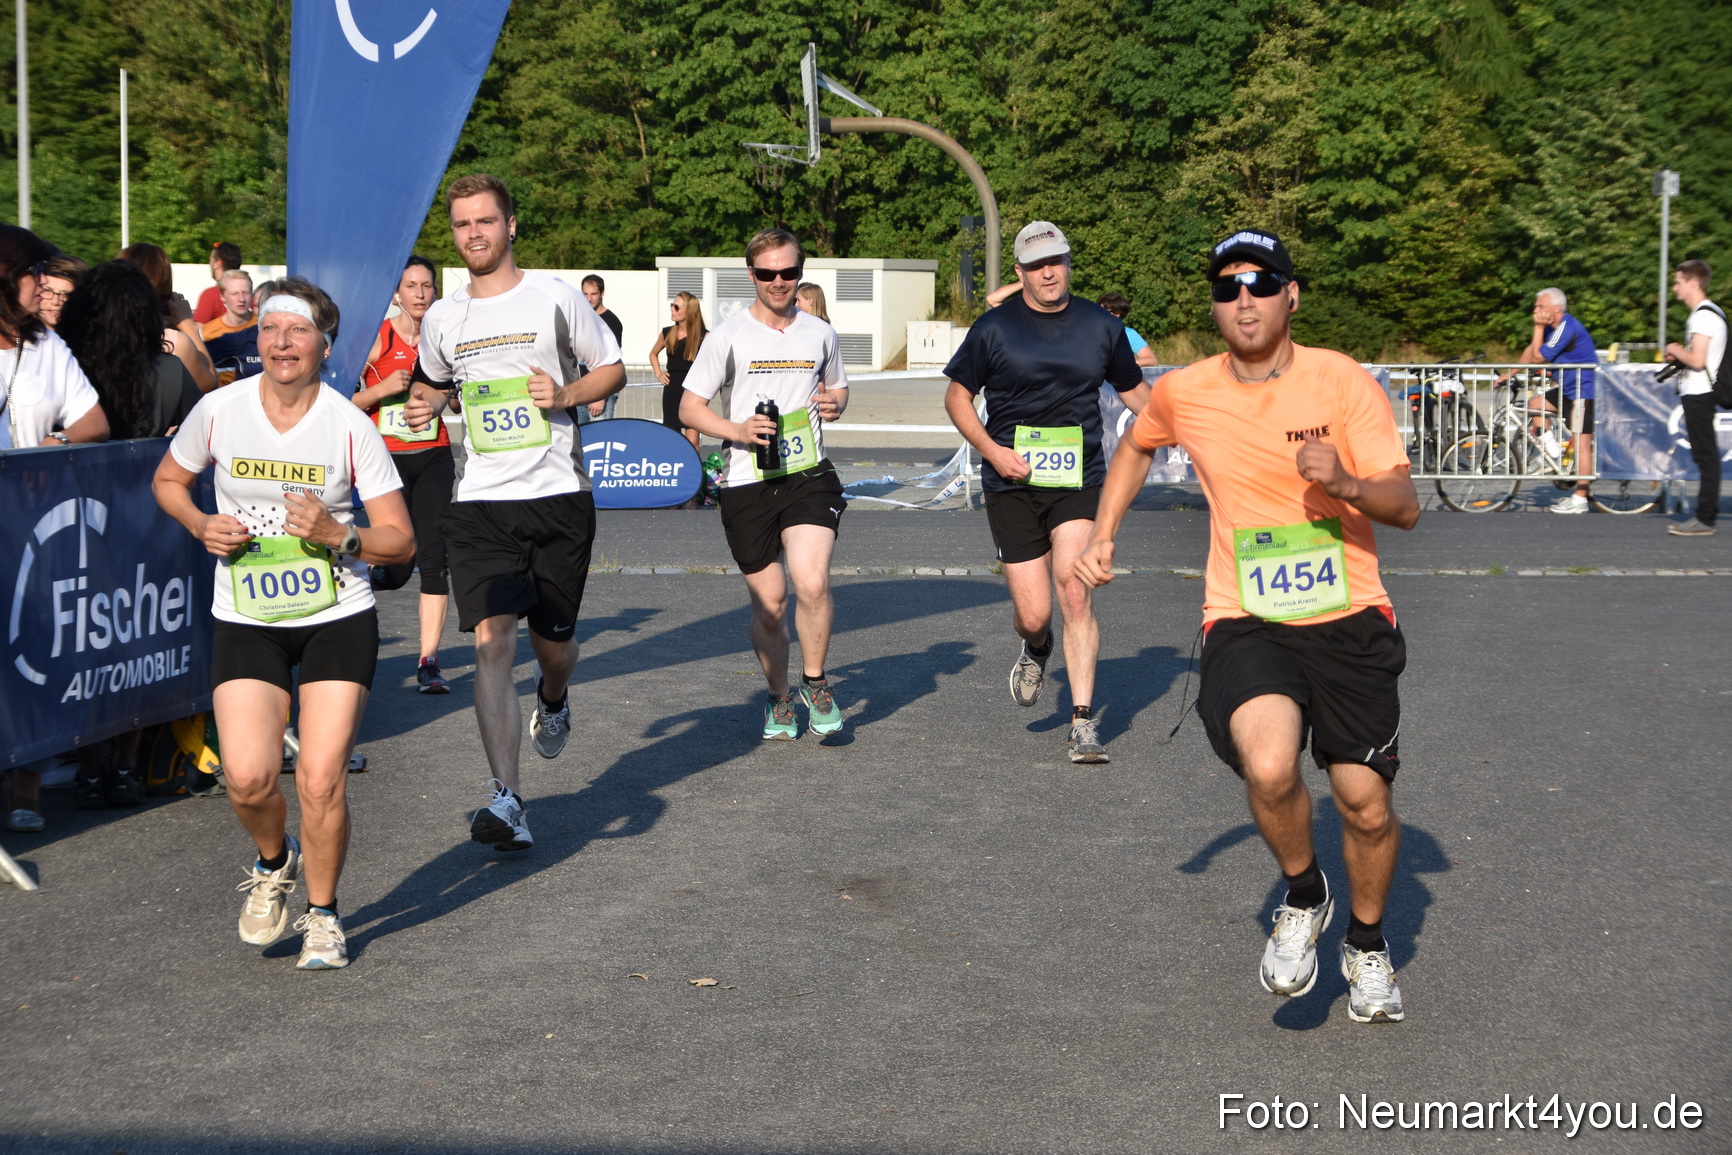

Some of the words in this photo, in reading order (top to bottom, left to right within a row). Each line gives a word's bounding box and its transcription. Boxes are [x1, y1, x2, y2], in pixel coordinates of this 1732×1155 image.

[1215, 231, 1276, 255] THULE
[481, 346, 512, 354] KOMPETENZ
[482, 406, 531, 433] 536
[780, 435, 804, 458] 33
[236, 460, 318, 483] ONLINE
[588, 458, 684, 477] Fischer
[1022, 450, 1076, 471] 1299
[281, 482, 326, 497] Germany
[598, 479, 678, 488] AUTOMOBILE
[241, 567, 322, 600] 1009
[1249, 556, 1338, 596] 1454
[258, 603, 287, 611] Christine
[1273, 600, 1298, 608] Patrick
[60, 644, 192, 704] AUTOMOBILE
